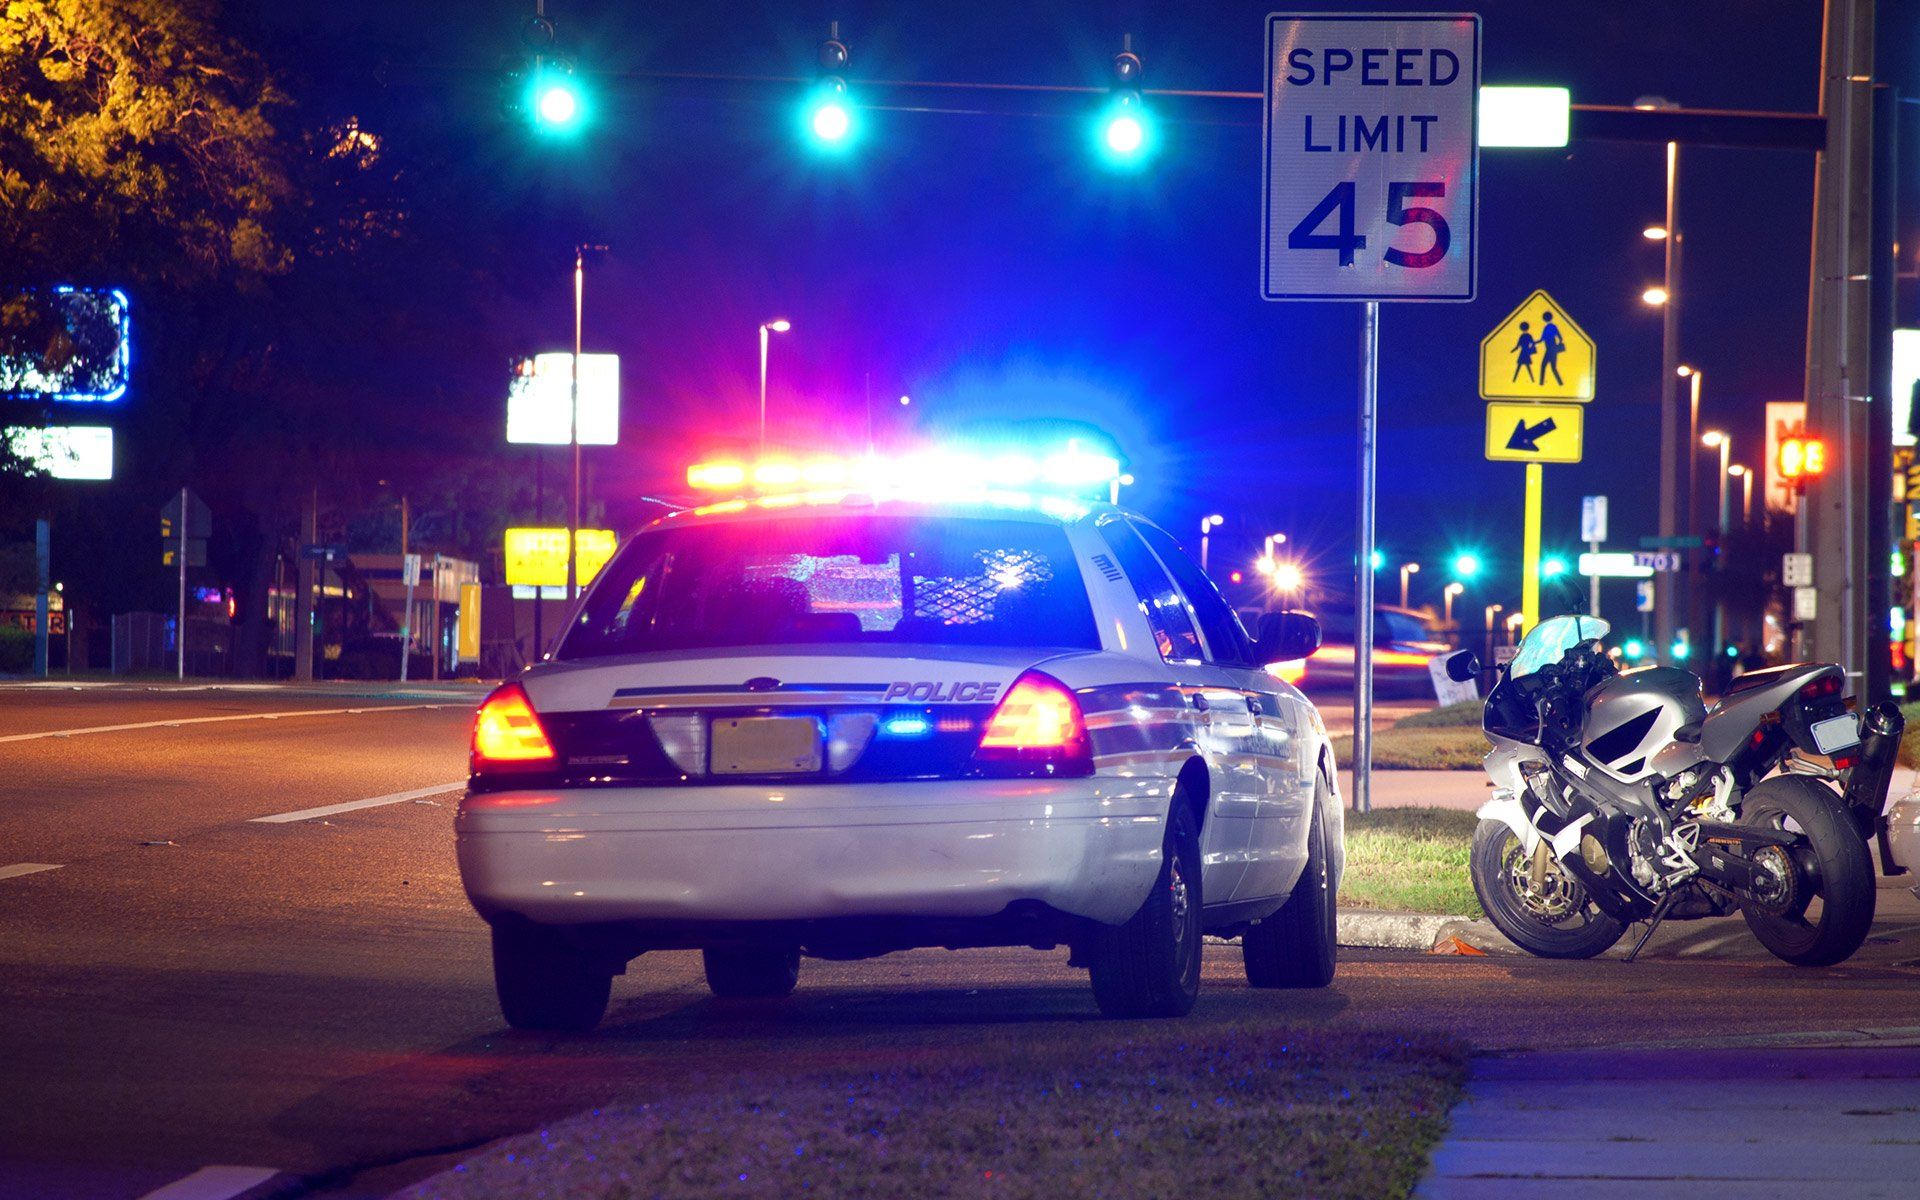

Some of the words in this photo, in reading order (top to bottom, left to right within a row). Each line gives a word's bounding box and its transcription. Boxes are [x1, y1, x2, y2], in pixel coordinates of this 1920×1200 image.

[1286, 48, 1460, 86] SPEED
[1304, 115, 1438, 152] LIMIT
[1288, 181, 1451, 268] 45
[884, 681, 1001, 702] POLICE
